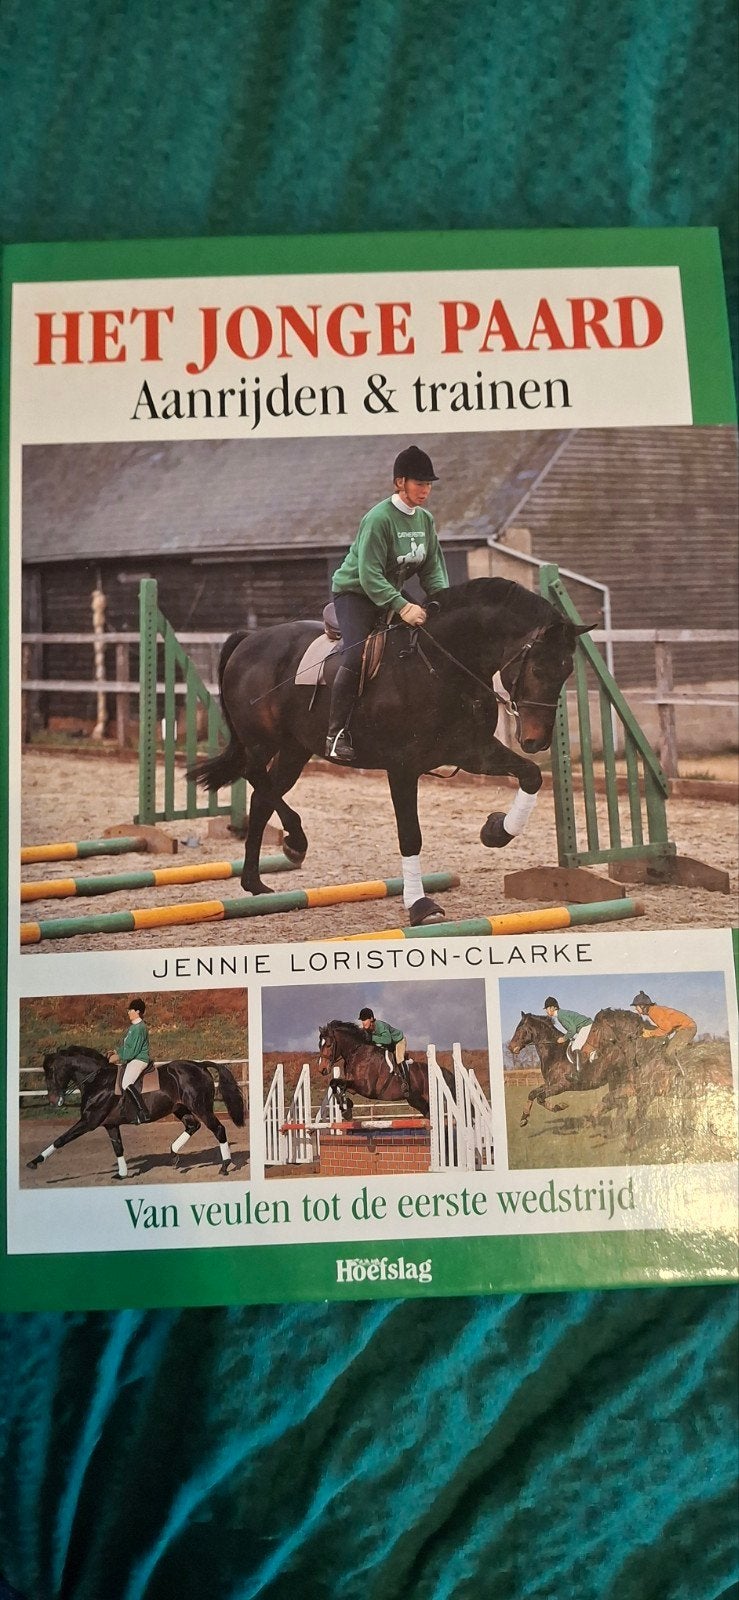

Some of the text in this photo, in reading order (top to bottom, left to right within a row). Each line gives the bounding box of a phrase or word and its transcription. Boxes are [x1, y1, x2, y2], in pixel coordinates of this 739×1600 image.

[35, 295, 664, 375] HET JONGE PAARD
[131, 371, 573, 430] Aanrijden & trainen
[152, 943, 594, 978] JENNIE LORISTON-CLARKE
[125, 1176, 635, 1229] Van veulen tot de eerste wedstrijd
[336, 1257, 432, 1283] Hoefslag
